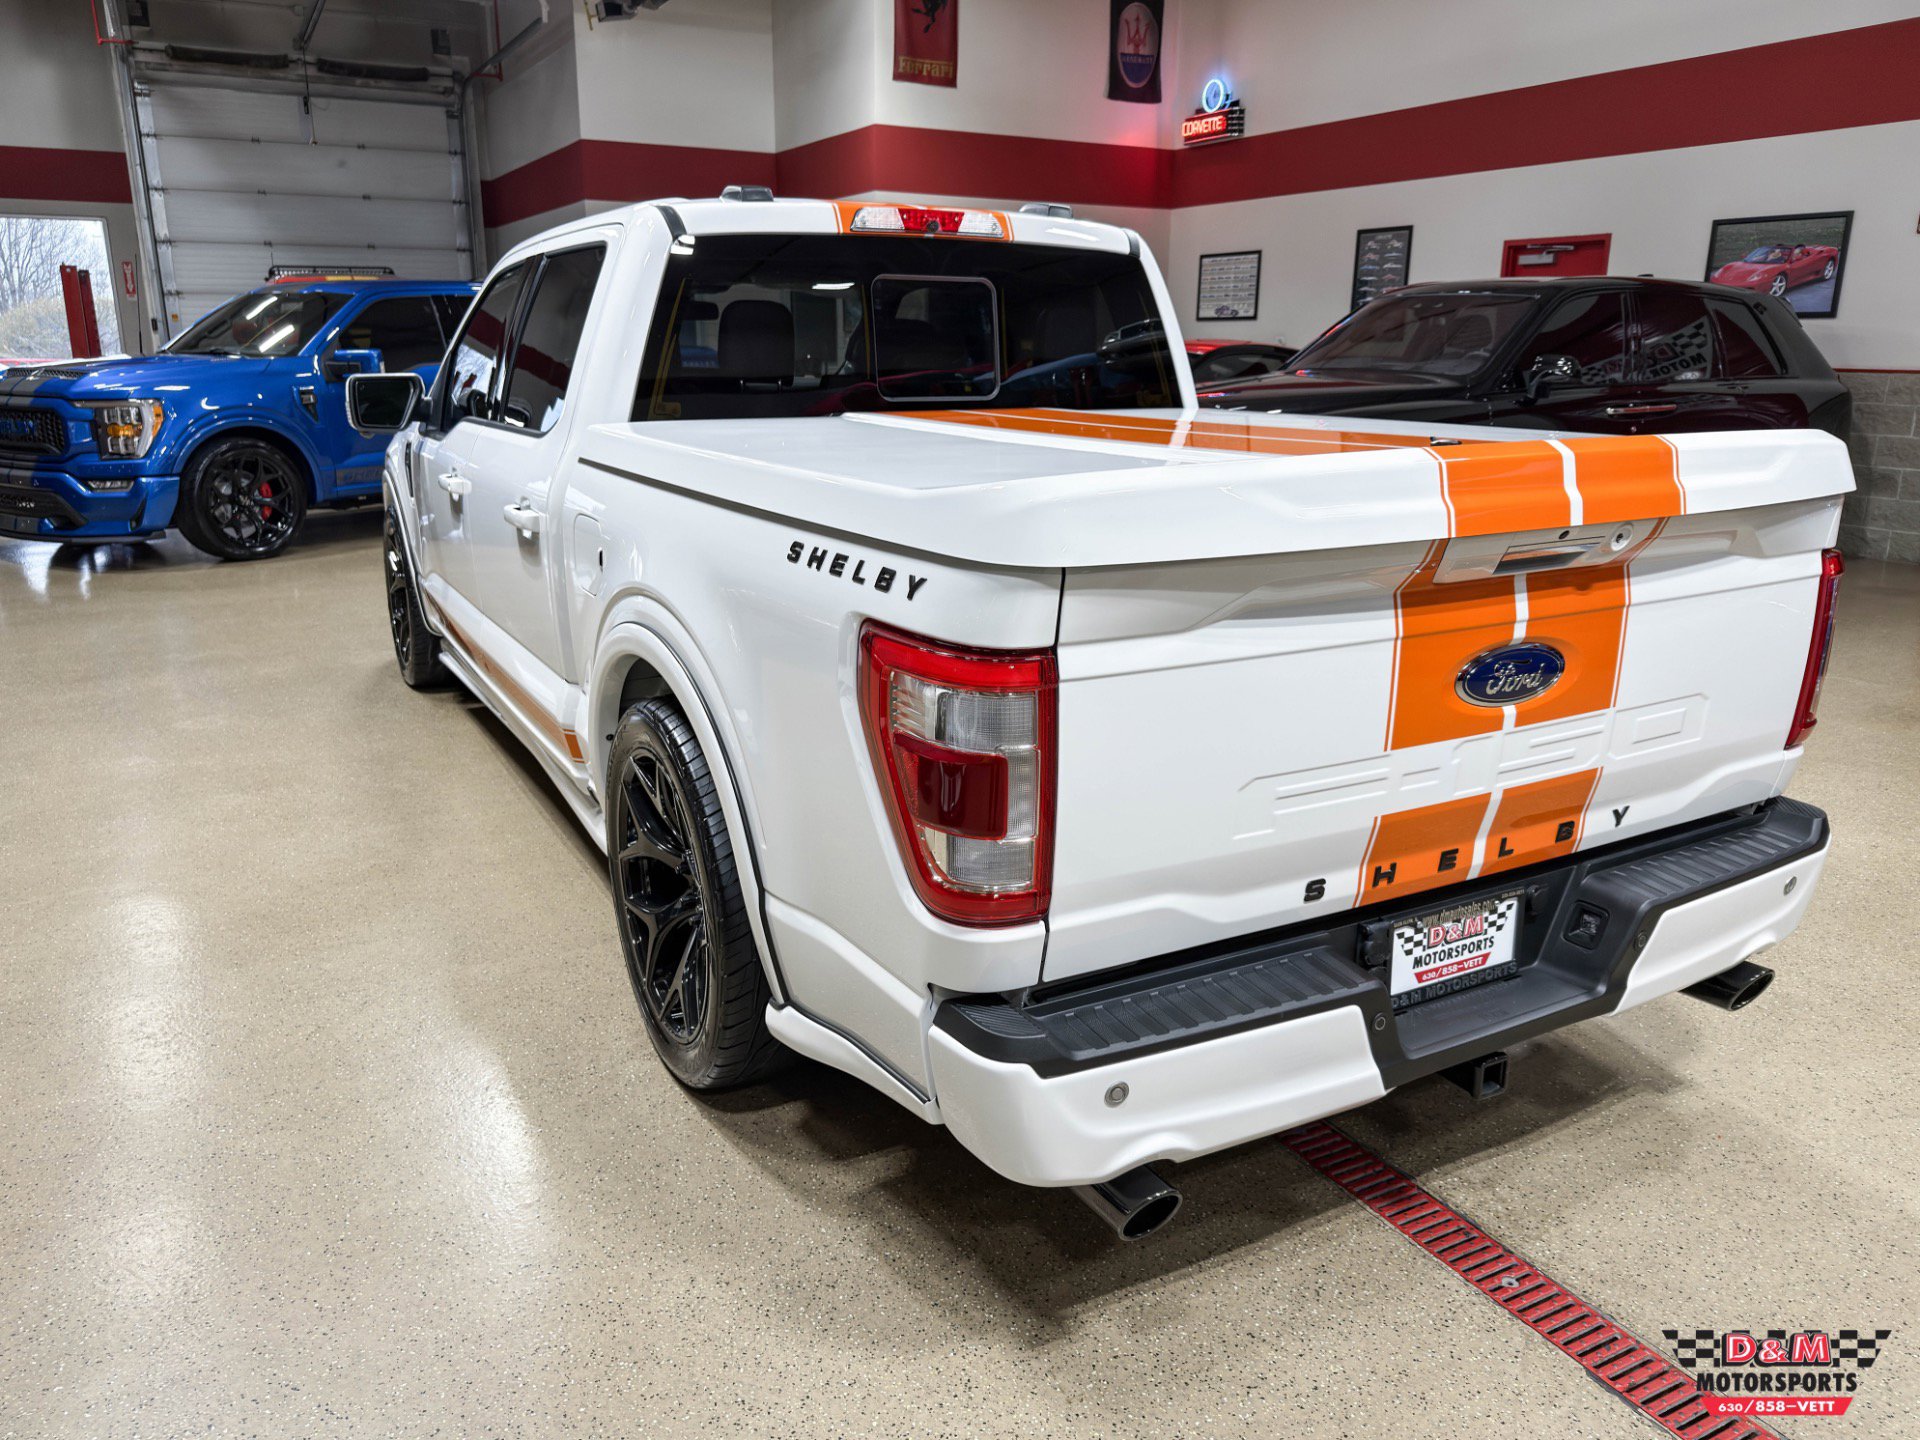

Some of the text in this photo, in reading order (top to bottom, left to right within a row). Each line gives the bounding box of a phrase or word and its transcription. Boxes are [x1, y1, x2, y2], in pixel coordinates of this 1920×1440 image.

[898, 55, 953, 78] Ferrari
[1181, 115, 1224, 137] CORVETTE
[786, 540, 928, 601] SHELBY
[1485, 660, 1546, 695] Ford
[1302, 804, 1631, 903] SHELBY
[1428, 914, 1485, 949] D&M
[1412, 936, 1495, 970] MOTORSPORTS
[1421, 956, 1485, 981] 630/858-VETT
[1426, 962, 1517, 998] MOTORSPORTS
